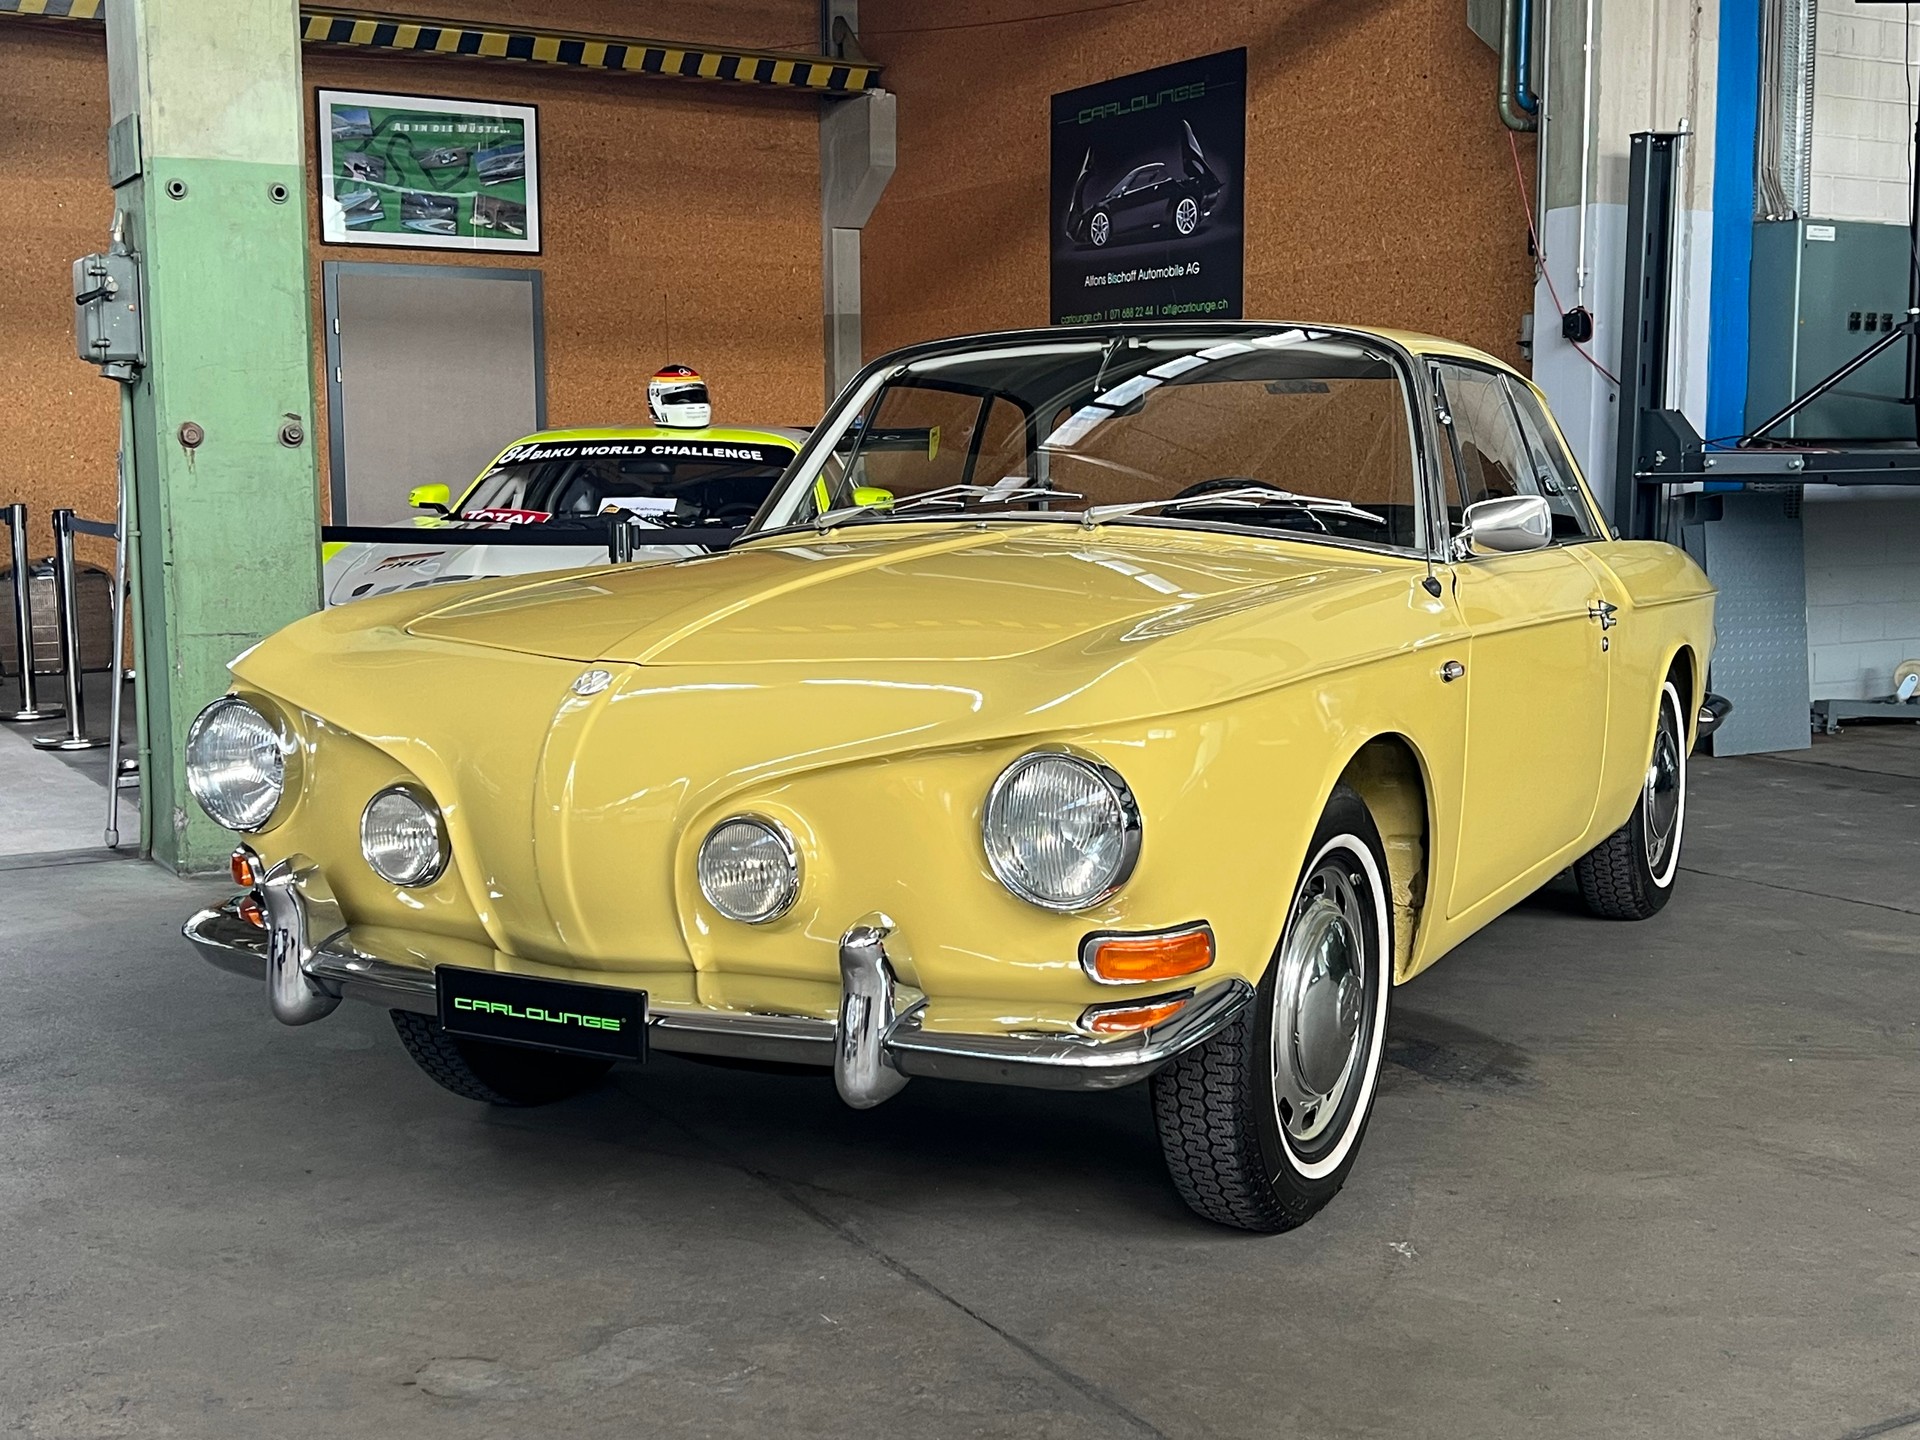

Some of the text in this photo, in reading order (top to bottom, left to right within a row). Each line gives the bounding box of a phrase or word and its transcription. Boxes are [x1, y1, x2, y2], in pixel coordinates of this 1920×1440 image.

[1078, 82, 1205, 124] CARLOUNGE
[433, 124, 454, 133] DIE
[1084, 261, 1201, 287] Alfons Bischoff Automobile AG
[1060, 311, 1102, 325] carlounge.ch
[1109, 308, 1121, 320] 071
[1121, 307, 1134, 319] 688
[1135, 306, 1144, 318] 22
[1145, 305, 1154, 316] 44
[1161, 298, 1229, 316] alf@carlounge.ch
[529, 445, 764, 461] BAKU WORLD CHALLENGE
[454, 997, 621, 1032] CARLOUNGE
